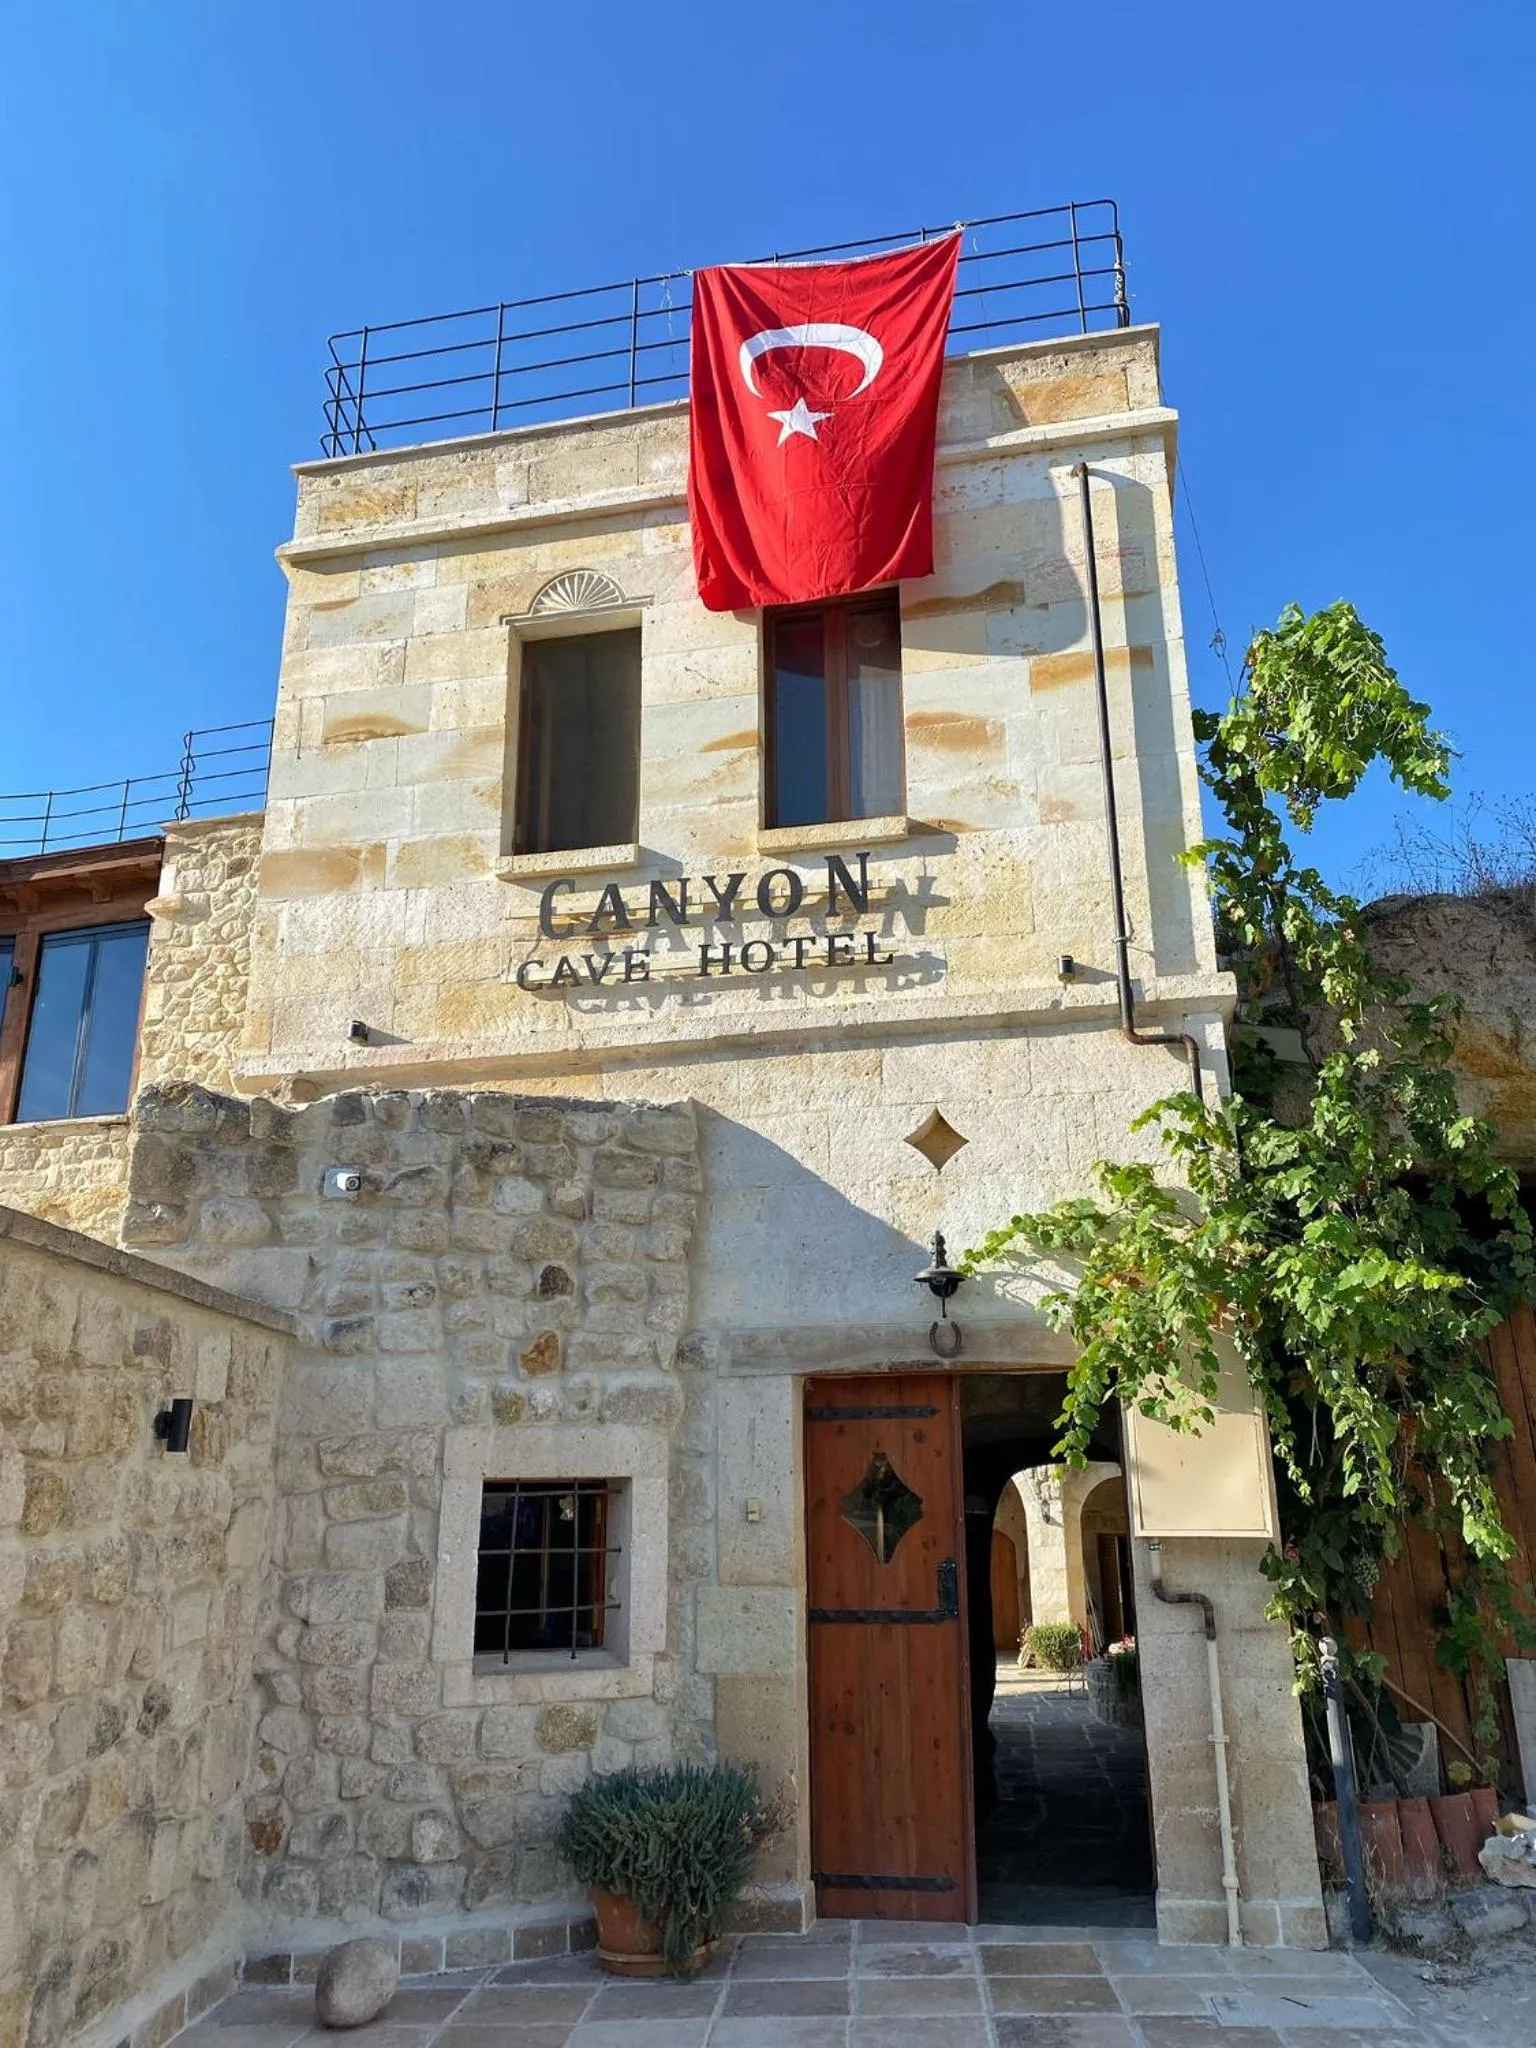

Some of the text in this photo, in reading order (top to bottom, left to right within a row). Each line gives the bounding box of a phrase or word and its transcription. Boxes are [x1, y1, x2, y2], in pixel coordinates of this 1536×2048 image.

[539, 852, 871, 940] CANYON
[517, 931, 894, 991] CAVE HOTEL
